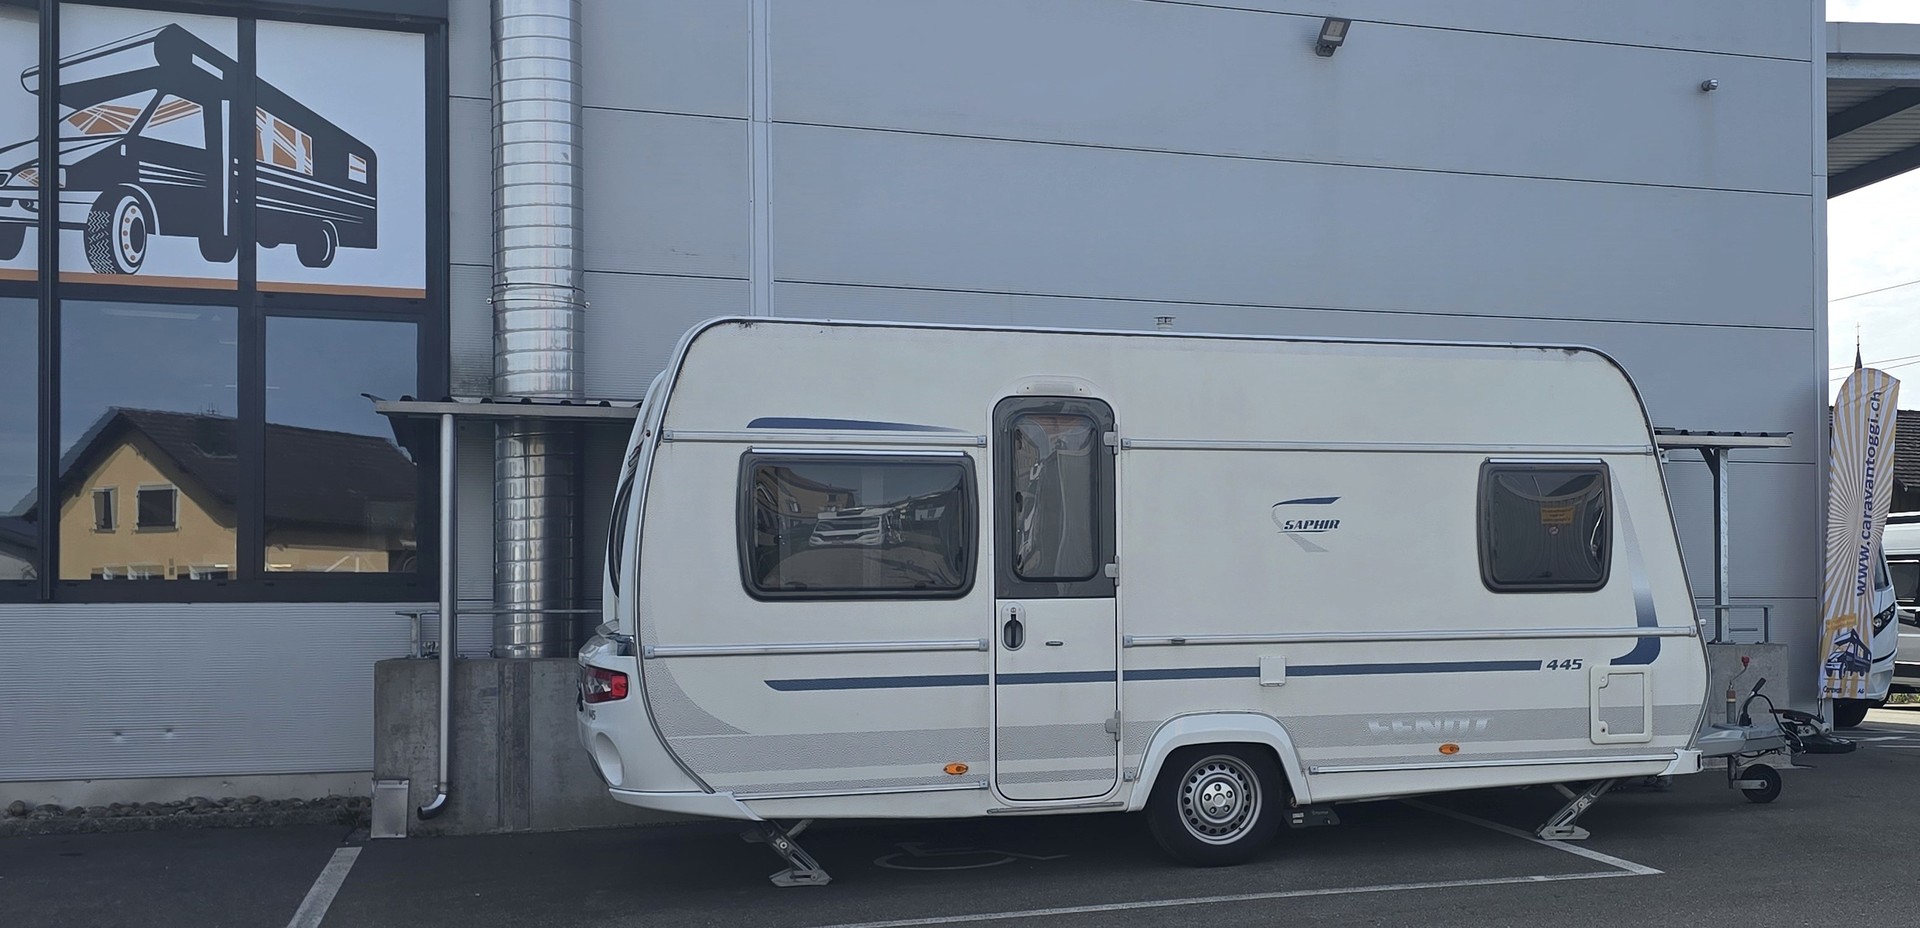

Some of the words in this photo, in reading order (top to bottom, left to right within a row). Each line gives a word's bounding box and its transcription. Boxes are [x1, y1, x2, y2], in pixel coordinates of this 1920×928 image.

[1856, 391, 1882, 597] www.caravantoggi.ch
[1283, 519, 1341, 530] SAPHIR
[1546, 658, 1583, 671] 445
